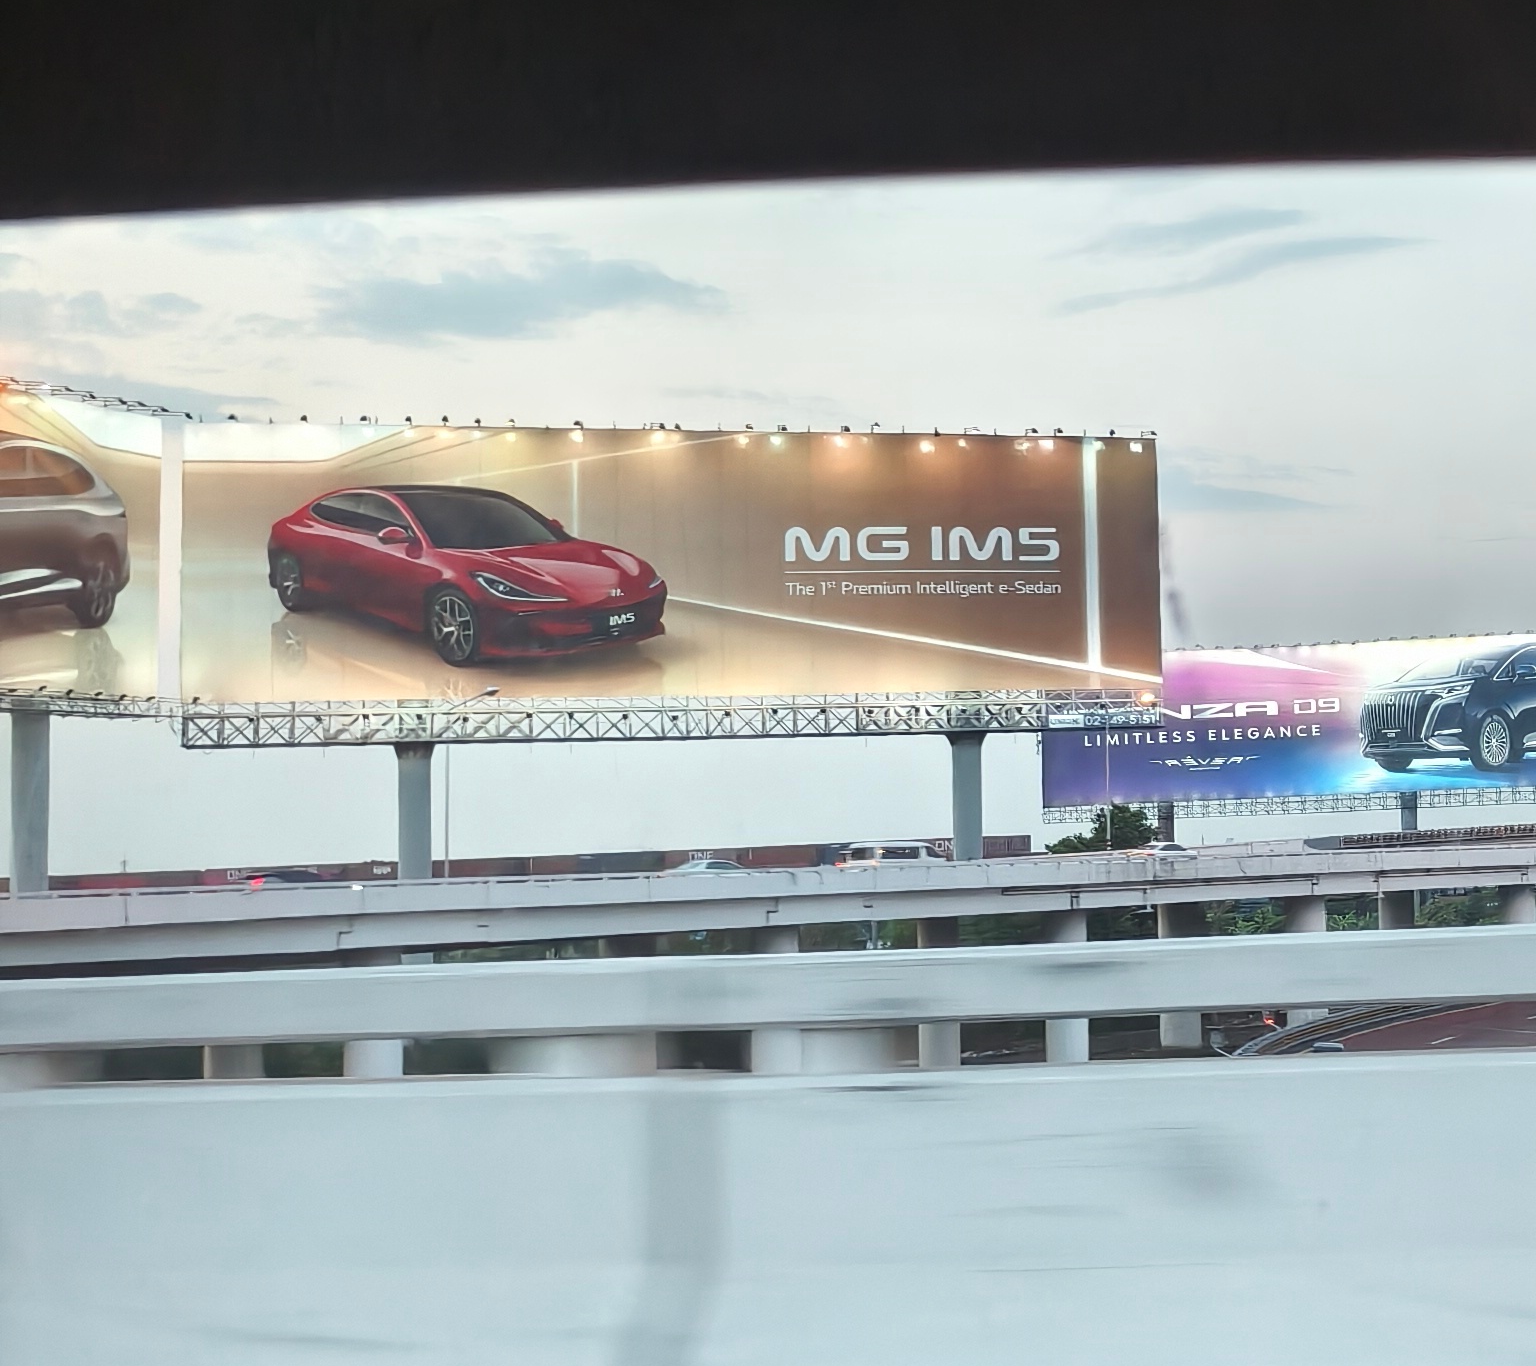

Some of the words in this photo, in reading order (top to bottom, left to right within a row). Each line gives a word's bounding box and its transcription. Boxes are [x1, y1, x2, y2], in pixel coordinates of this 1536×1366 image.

[784, 526, 910, 562] MG
[931, 526, 1060, 561] IM5
[785, 581, 815, 596] The
[820, 580, 837, 595] 1st
[841, 581, 911, 595] Premium
[916, 580, 995, 598] Intelligent
[998, 580, 1062, 595] e-Sedan
[1293, 697, 1341, 715] D9
[1084, 730, 1196, 747] LIMITLESS
[1208, 724, 1321, 740] ELEGANCE
